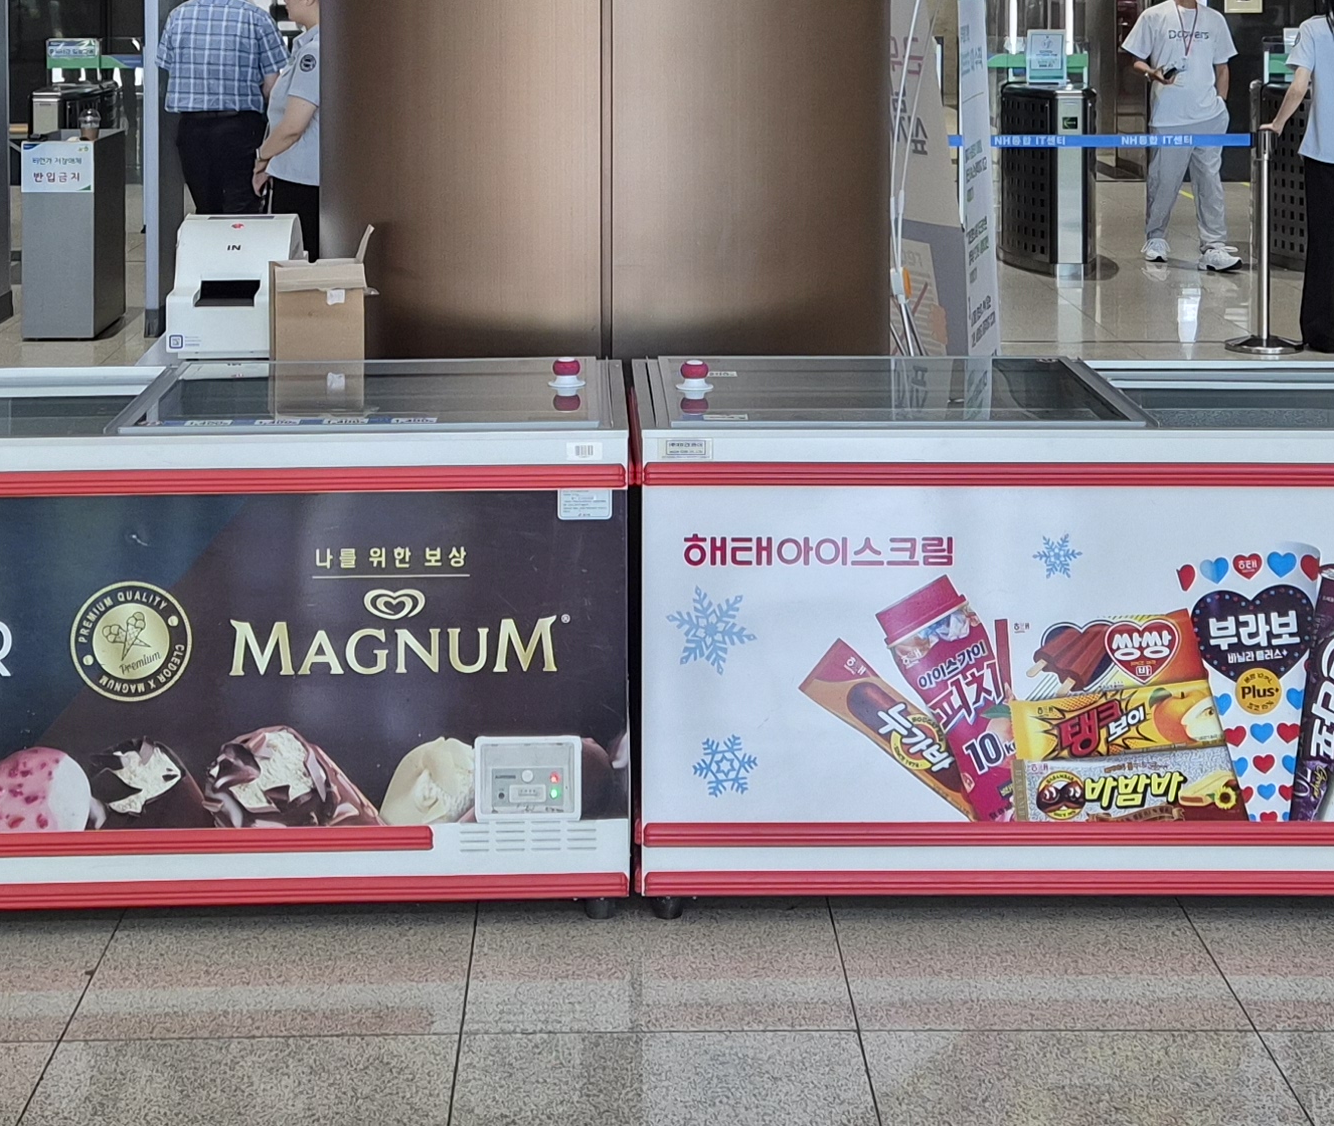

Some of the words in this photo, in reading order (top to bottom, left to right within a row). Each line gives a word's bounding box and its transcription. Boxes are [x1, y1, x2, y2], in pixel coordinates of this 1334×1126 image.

[33, 171, 81, 183] 반입금지
[227, 244, 242, 252] IN
[315, 547, 357, 569] 나를
[368, 547, 411, 569] 위한
[424, 546, 467, 568] 보상
[683, 534, 955, 567] 해태아이스크림
[78, 596, 114, 644] PREMIUM
[117, 590, 168, 610] QUALITY
[1208, 610, 1301, 651] 부라보
[119, 651, 163, 676] Premium
[157, 644, 185, 684] CLEDOR
[229, 614, 559, 676] MAGNUM
[928, 660, 1005, 733] 피치
[878, 702, 956, 773] 누가바
[963, 732, 1005, 775] 10
[1084, 771, 1188, 811] 바밤바
